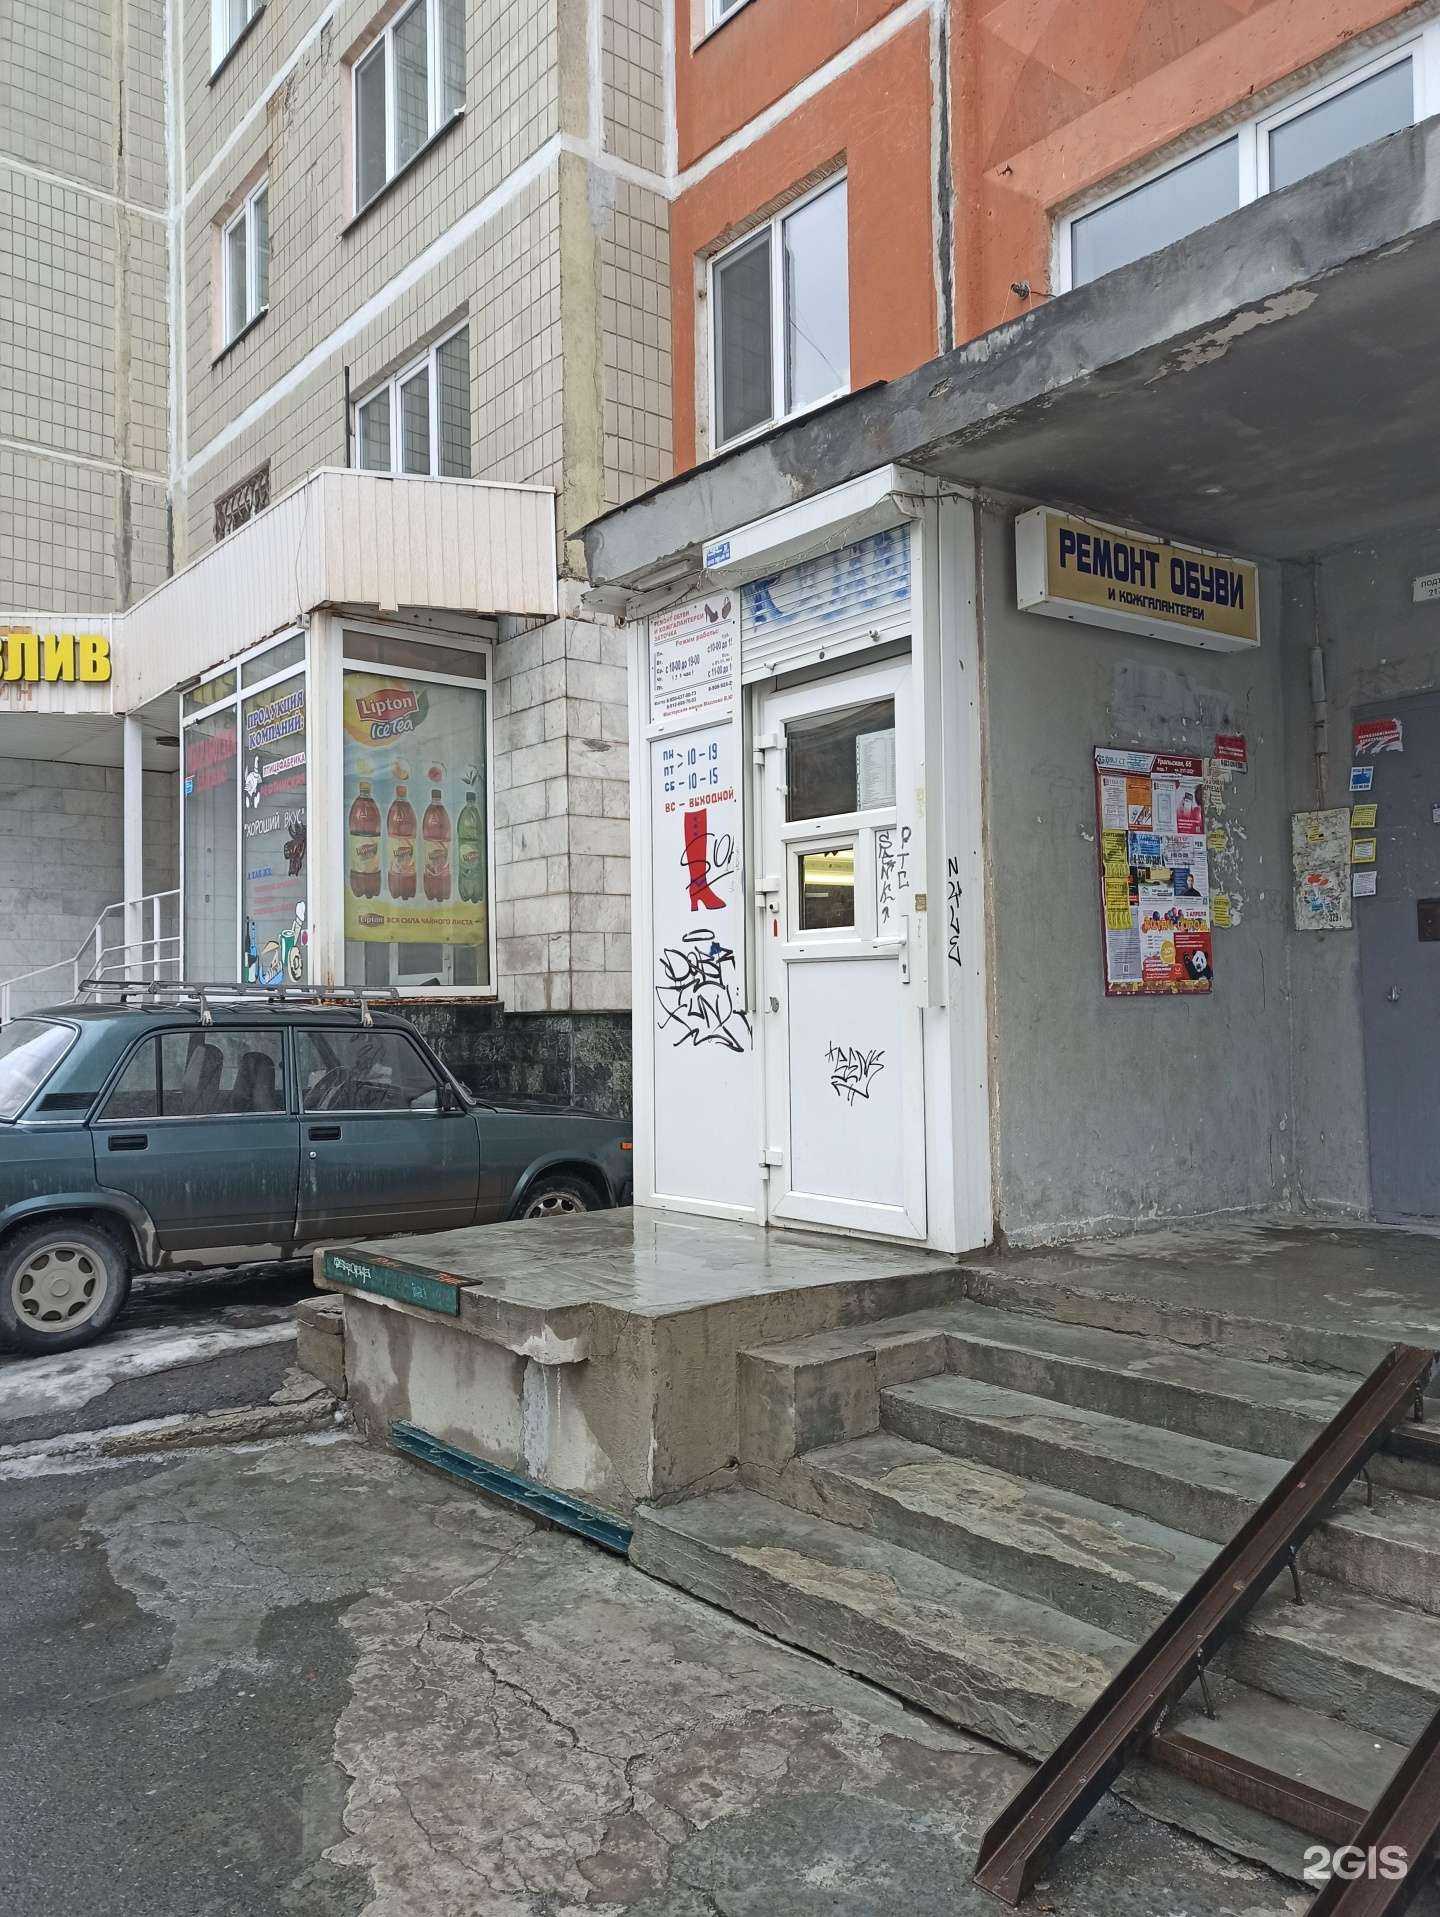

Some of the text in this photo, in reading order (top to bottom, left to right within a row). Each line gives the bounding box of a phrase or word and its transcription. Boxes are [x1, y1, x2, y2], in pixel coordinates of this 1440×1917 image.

[1059, 528, 1244, 609] РЕМОНТ ОБУВИ
[1108, 587, 1115, 600] И
[0, 633, 111, 682] ЛИВ
[246, 689, 304, 730] ПРОДУКЦИЯ
[361, 697, 412, 716] Lipton
[663, 749, 674, 760] ПН
[664, 765, 674, 776] ПТ
[665, 781, 675, 792] СБ
[665, 802, 675, 812] ВС
[689, 786, 734, 807] ВЫХОДНОЙ
